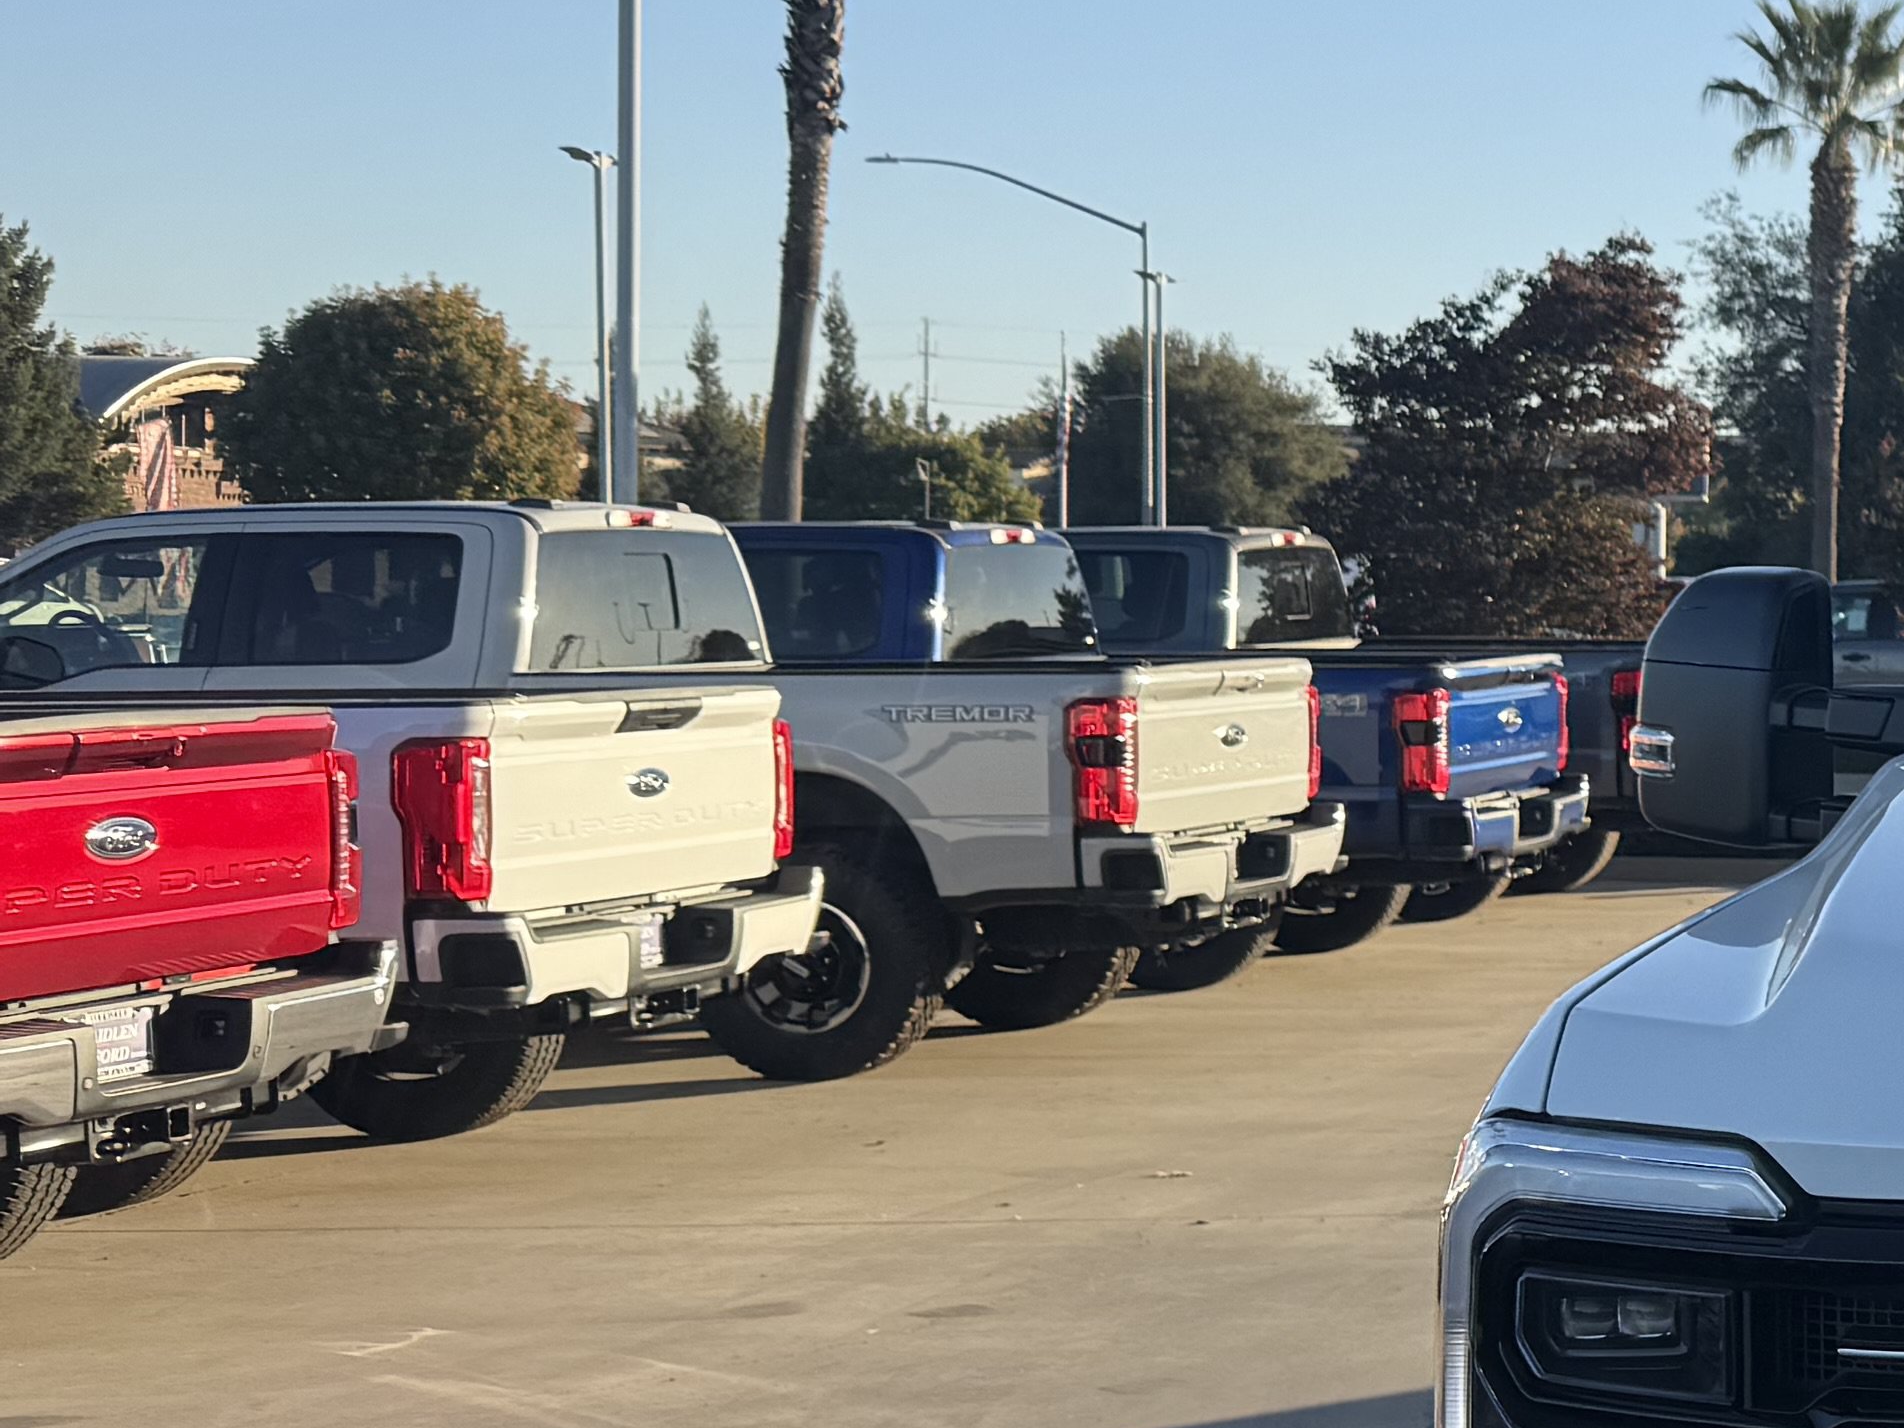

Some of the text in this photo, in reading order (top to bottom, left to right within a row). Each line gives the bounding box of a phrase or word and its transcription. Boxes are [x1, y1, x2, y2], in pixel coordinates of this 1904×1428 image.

[883, 704, 1036, 723] TREMOR
[512, 800, 766, 845] SUPER DUTY
[4, 853, 313, 915] PER DUTY
